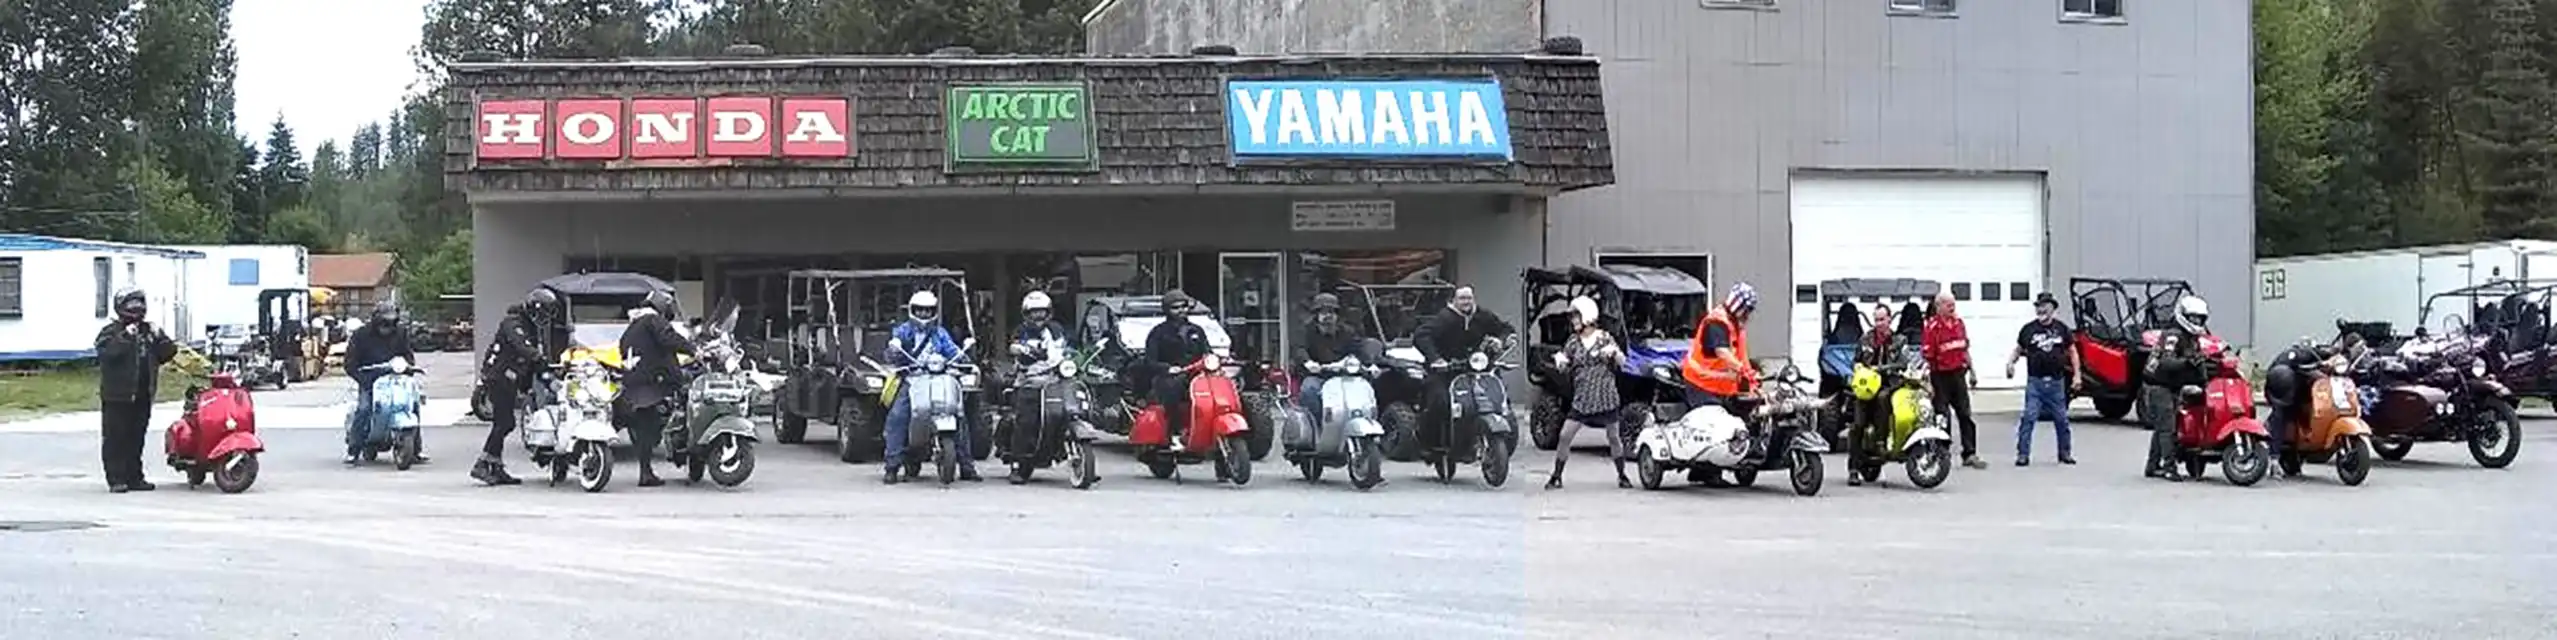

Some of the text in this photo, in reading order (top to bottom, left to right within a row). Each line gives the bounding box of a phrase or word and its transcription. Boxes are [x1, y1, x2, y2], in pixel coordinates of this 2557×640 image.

[962, 93, 1077, 119] ARCTIC
[1235, 89, 1496, 145] YAMAHA
[483, 112, 844, 144] HONDA
[991, 126, 1049, 153] CAT
